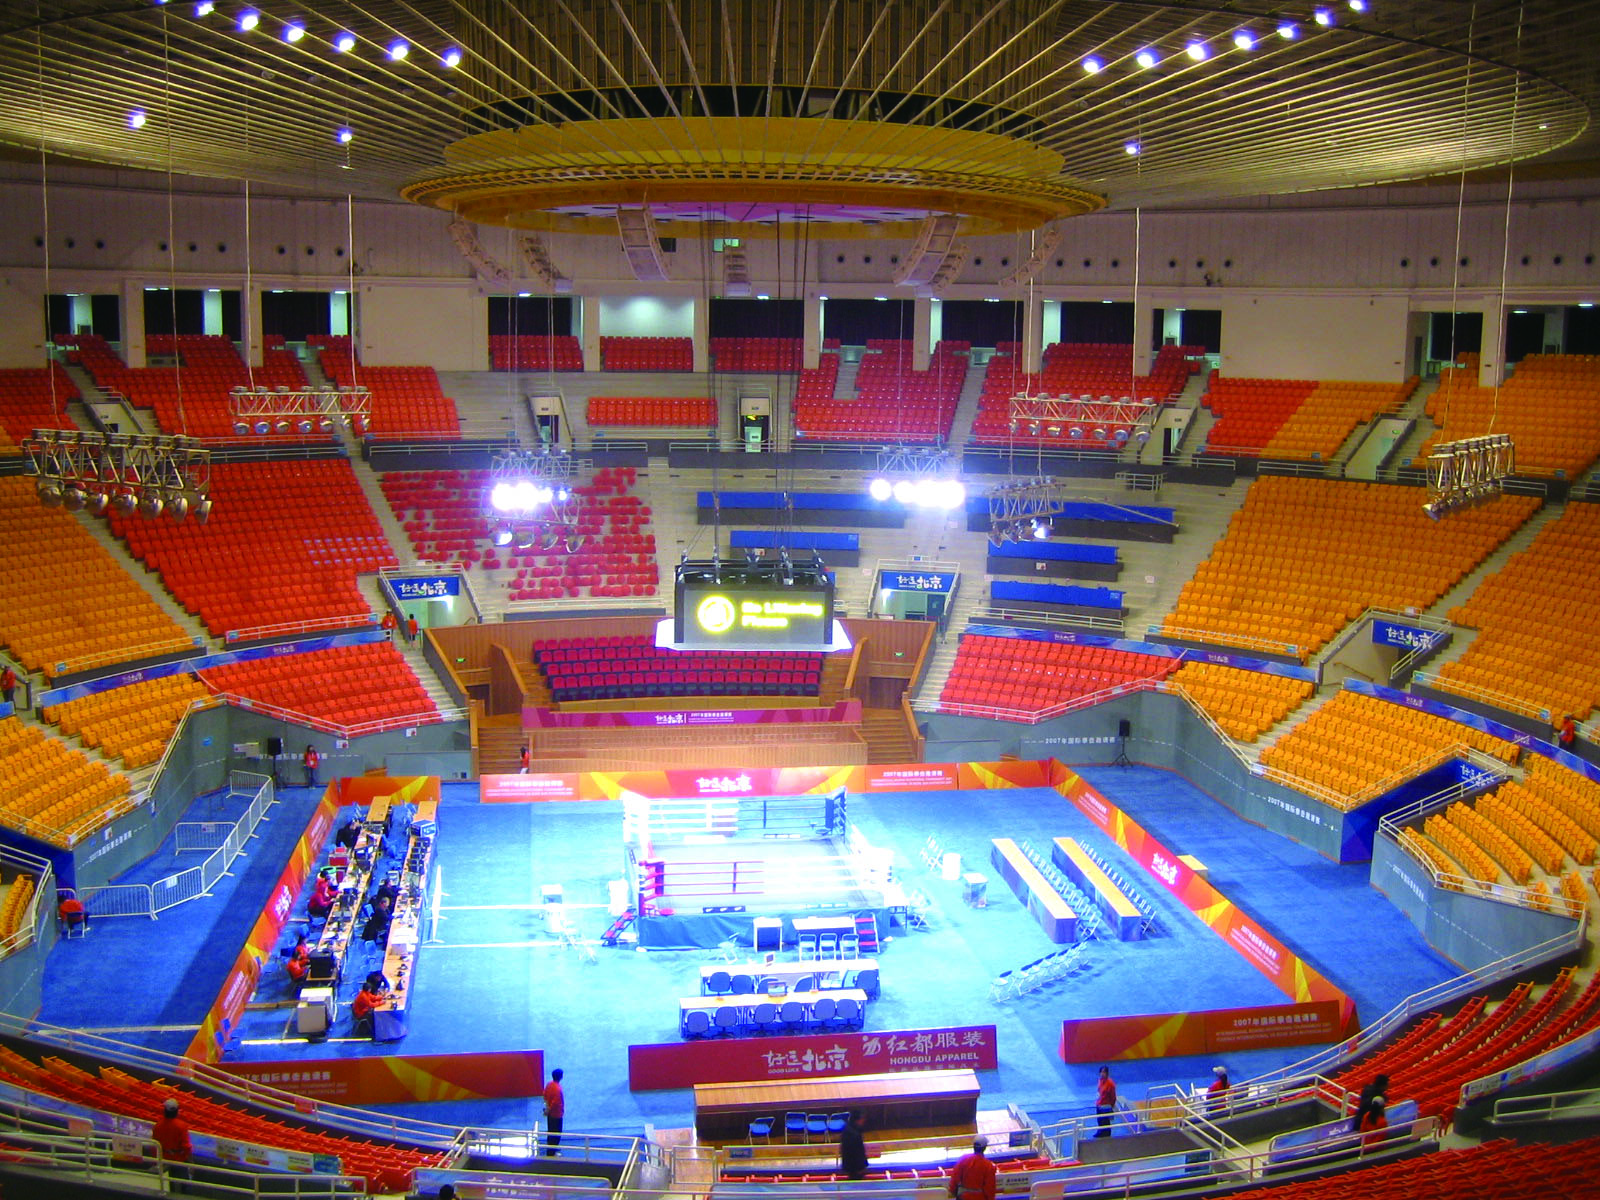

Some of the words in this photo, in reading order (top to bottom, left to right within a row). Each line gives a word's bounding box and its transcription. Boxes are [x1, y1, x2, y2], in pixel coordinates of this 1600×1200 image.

[886, 1031, 986, 1056] 红都服装
[761, 1043, 849, 1072] 好运北京
[890, 1055, 931, 1065] HONGDU
[935, 1052, 979, 1062] APPAREL
